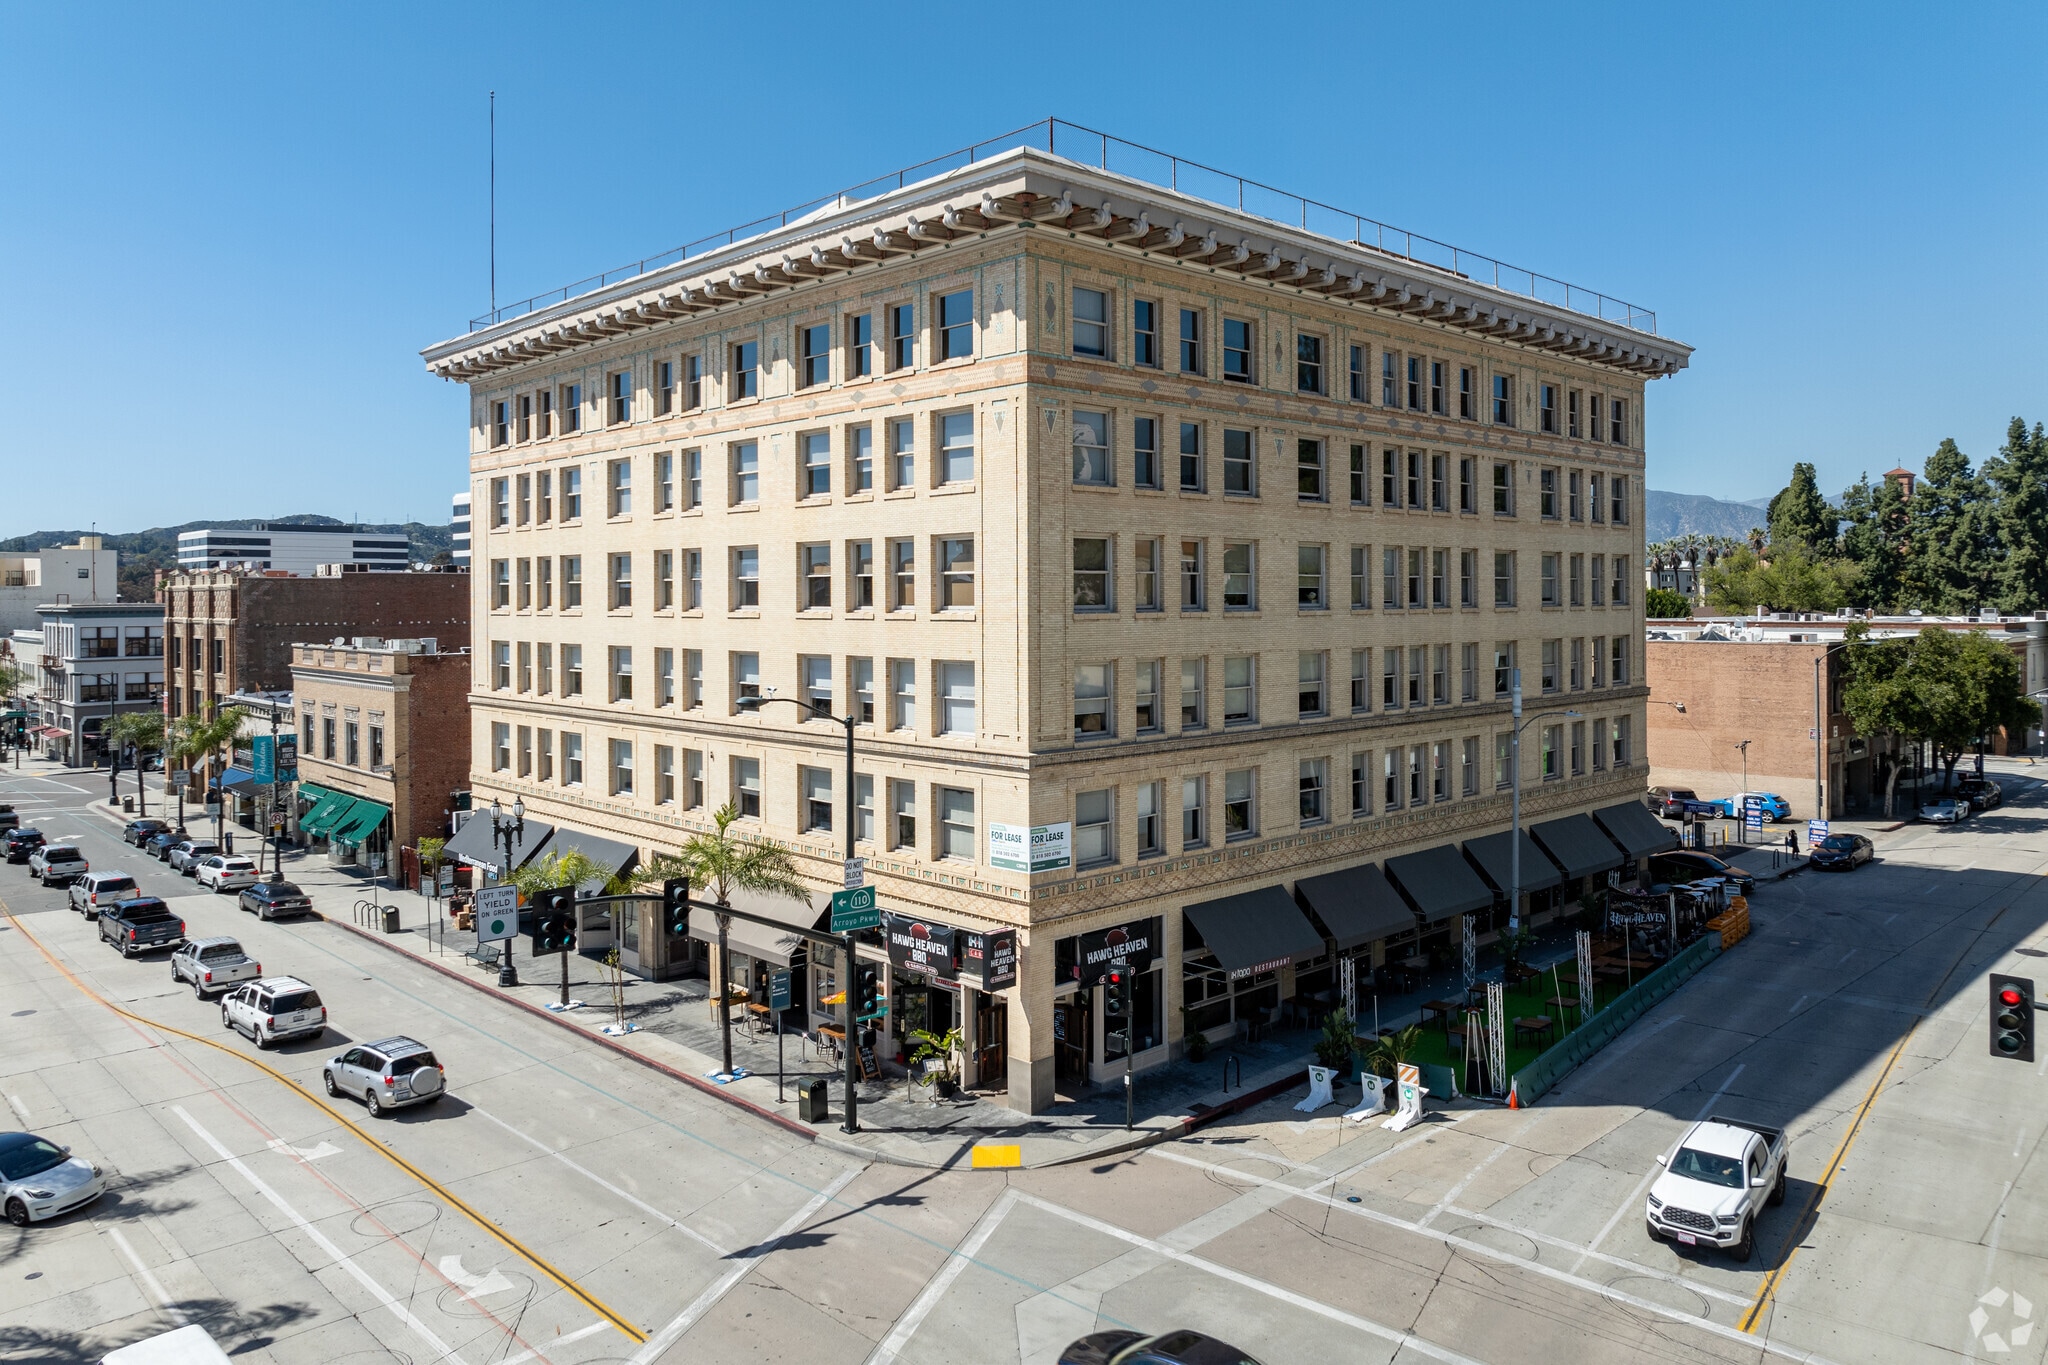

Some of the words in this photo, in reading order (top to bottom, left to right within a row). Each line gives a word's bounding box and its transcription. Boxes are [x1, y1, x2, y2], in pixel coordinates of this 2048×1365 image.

[991, 831, 1003, 840] FOR
[1004, 833, 1022, 843] LEASE
[1031, 835, 1044, 844] FOR
[1045, 832, 1064, 842] LEASE
[487, 862, 499, 874] Food
[846, 862, 853, 870] DO
[853, 861, 862, 869] NOT
[846, 871, 862, 879] BLOCK
[480, 892, 494, 900] LEFT
[854, 895, 868, 906] 110
[484, 899, 511, 909] YIELD
[493, 908, 514, 916] GREEN
[833, 918, 857, 927] Arroyo
[859, 915, 879, 924] Pkwy
[892, 932, 915, 948] HAWG
[915, 938, 948, 957] HEAVEN
[1087, 947, 1112, 964] HAWG
[1113, 937, 1148, 957] HEAVEN
[912, 949, 927, 965] BBQ
[994, 948, 1012, 958] HAWG
[990, 955, 1015, 968] HEAVEN
[1254, 957, 1290, 972] RESTAURANT
[997, 965, 1009, 974] BBQ
